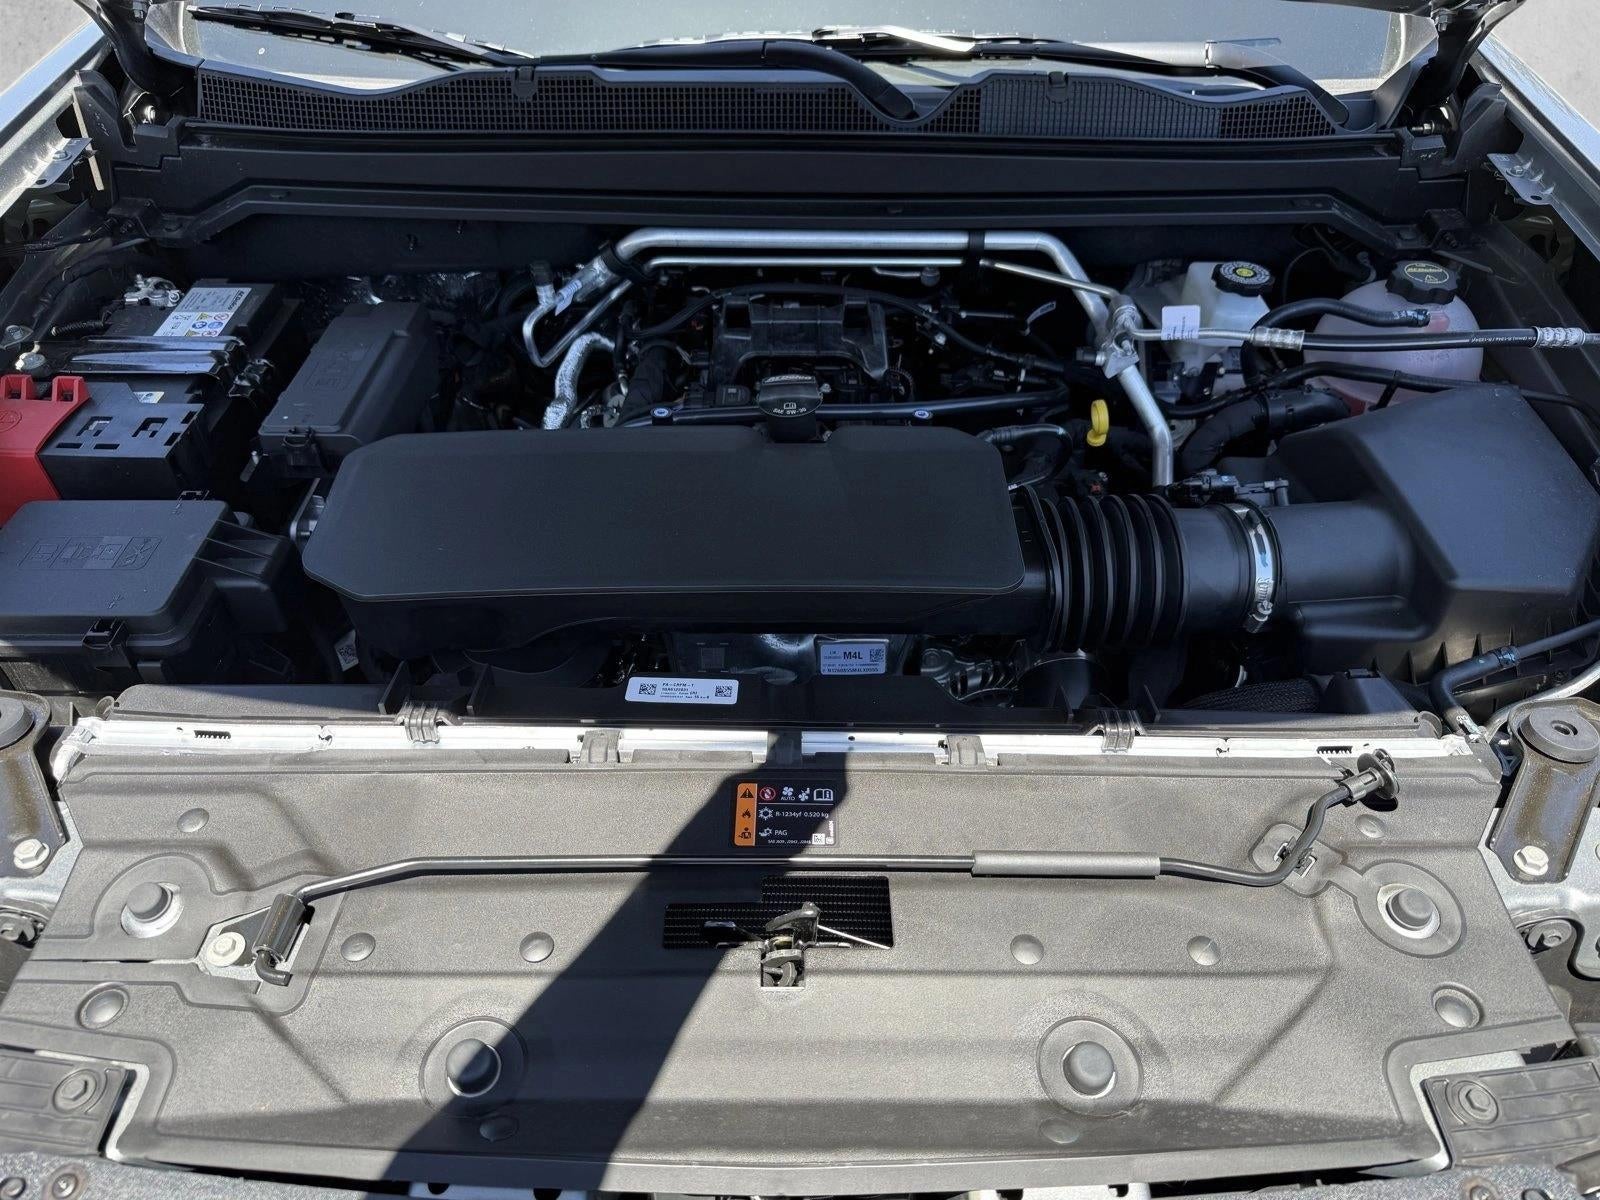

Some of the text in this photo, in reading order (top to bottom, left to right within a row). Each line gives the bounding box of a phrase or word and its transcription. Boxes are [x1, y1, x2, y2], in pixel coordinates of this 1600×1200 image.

[764, 375, 812, 383] ACDelco
[843, 651, 864, 660] M4L
[821, 811, 829, 819] kg
